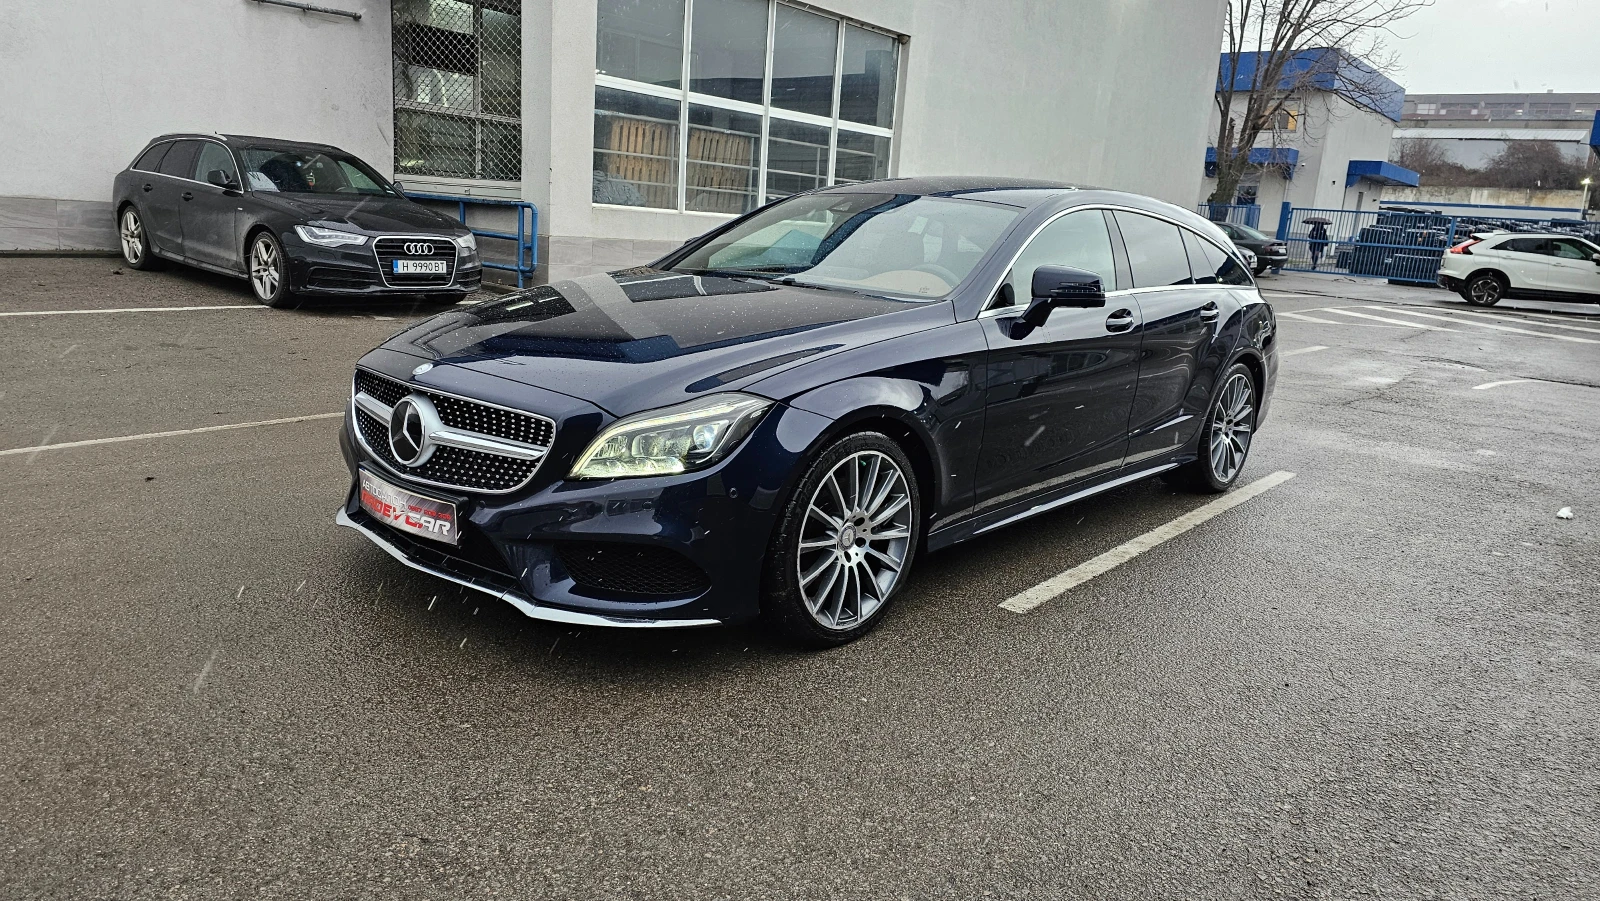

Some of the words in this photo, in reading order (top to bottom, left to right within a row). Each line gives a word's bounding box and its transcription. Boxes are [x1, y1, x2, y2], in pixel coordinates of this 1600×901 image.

[402, 262, 409, 272] H
[412, 262, 433, 272] 9990
[434, 262, 445, 272] BT
